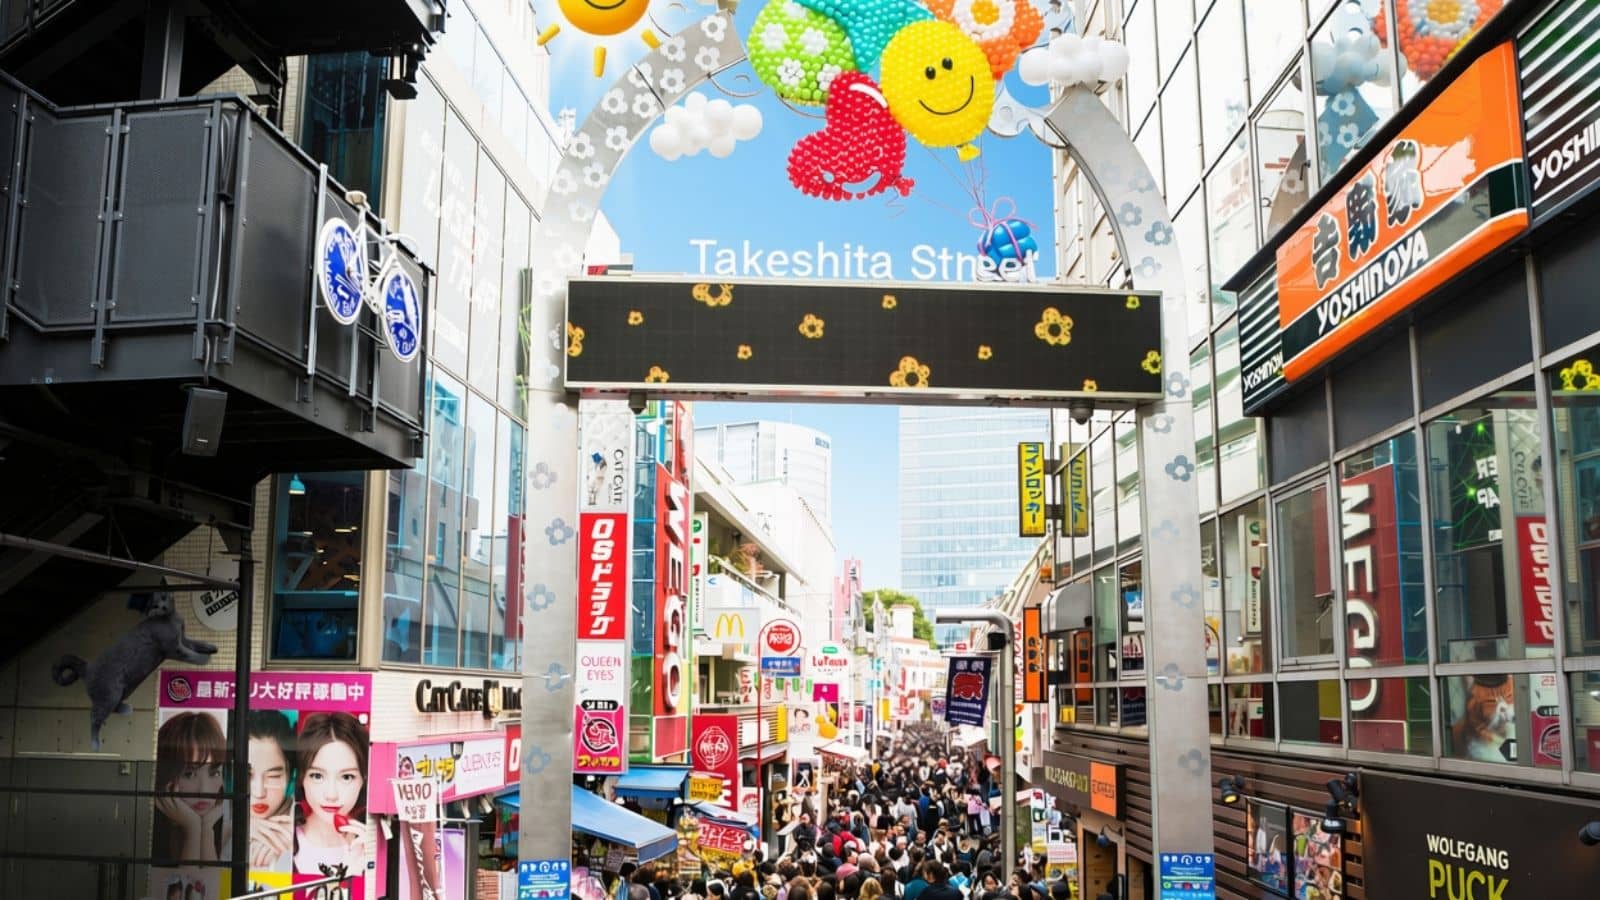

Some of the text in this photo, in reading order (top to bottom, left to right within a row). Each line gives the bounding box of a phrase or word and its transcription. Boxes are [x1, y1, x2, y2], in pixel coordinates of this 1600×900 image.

[1311, 138, 1426, 291] 吉野家
[689, 239, 894, 279] Takeshita
[1316, 229, 1430, 336] YOSHINOYA
[589, 518, 615, 635] OSドラッグ
[581, 655, 621, 668] QUEEN
[586, 669, 615, 681] EYES
[1426, 833, 1510, 870] WOLFGANG
[1428, 858, 1510, 900] PUCK
